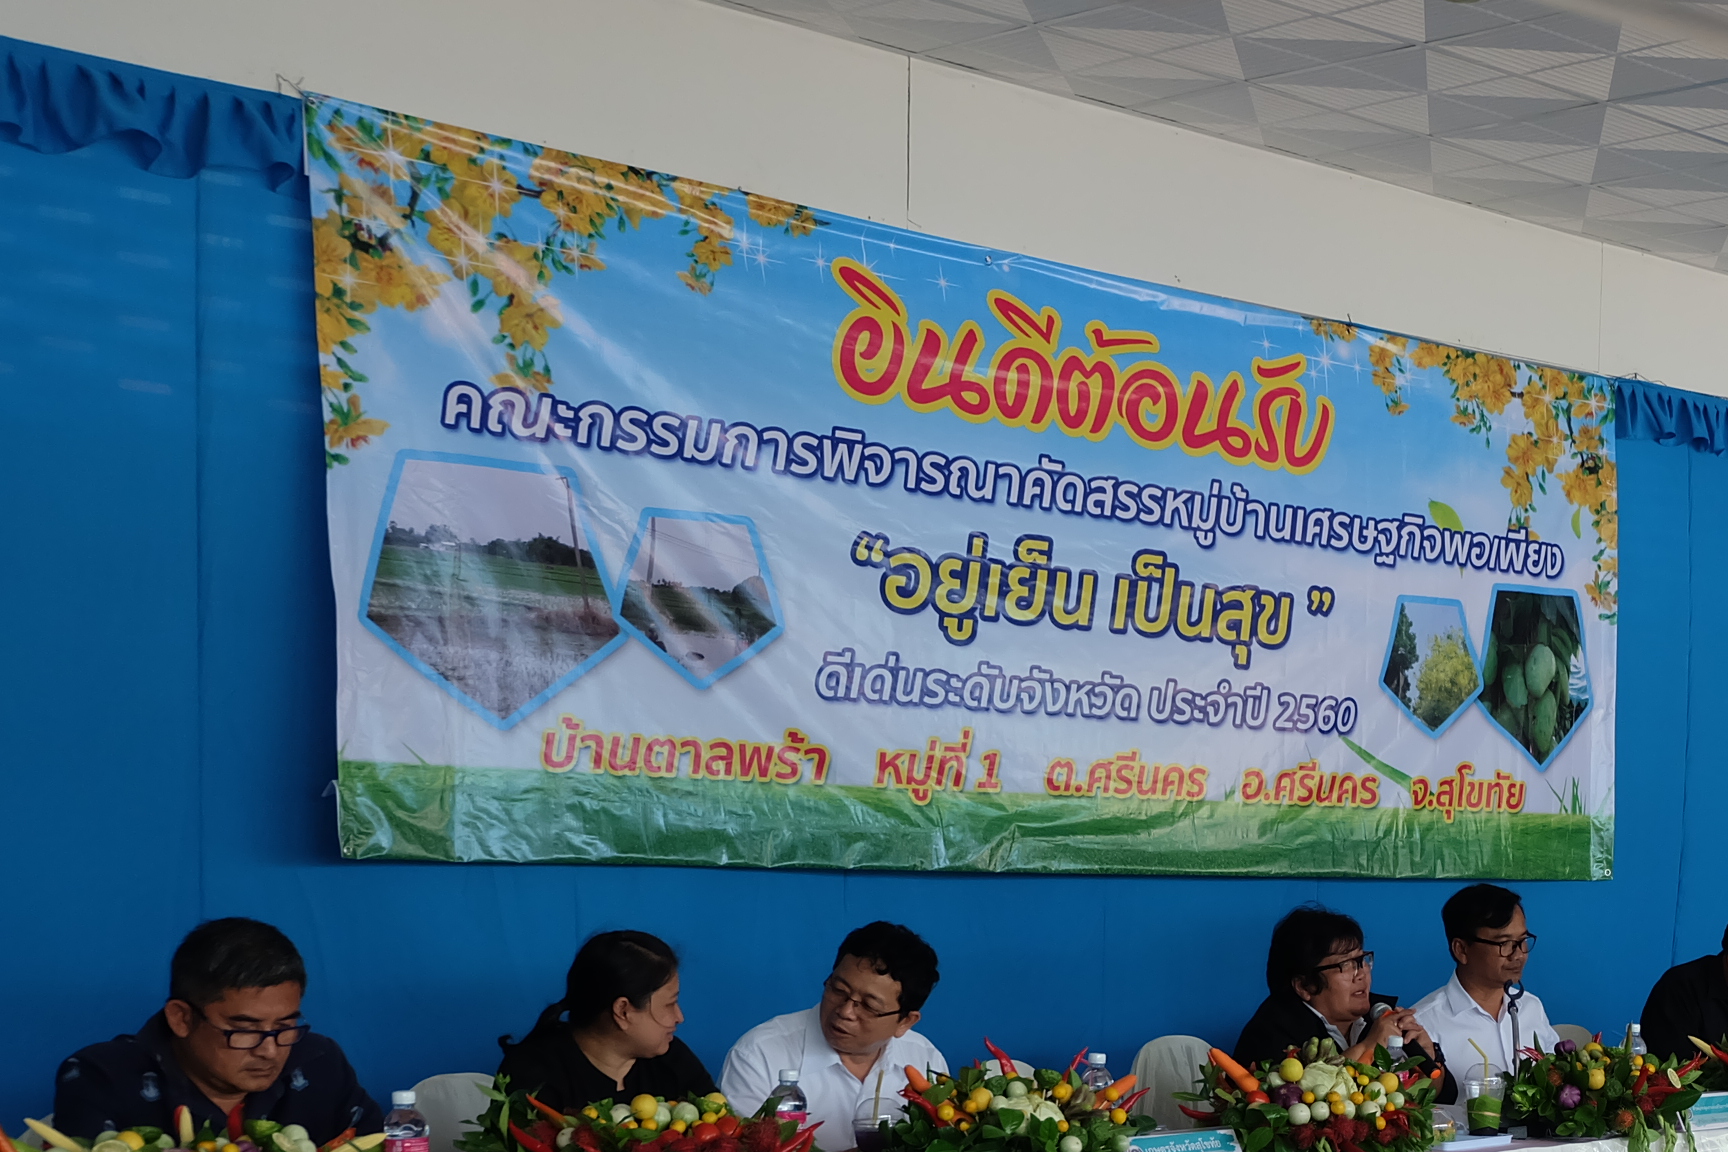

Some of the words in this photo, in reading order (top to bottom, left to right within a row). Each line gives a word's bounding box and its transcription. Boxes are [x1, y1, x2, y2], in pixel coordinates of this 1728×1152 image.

[442, 380, 1564, 579] คณะกรรมการพิจารณาคัดสรรหมู่บ้านเศรษฐกิจพอเพียง
[815, 648, 1140, 720] ดีเด่นระดับจังหวัด
[1147, 677, 1270, 729] ประจำปี
[1274, 691, 1358, 737] 2560
[542, 713, 830, 786] บ้านตาลพร้า
[875, 726, 973, 806] หมู่ที่
[975, 748, 1002, 794] 1
[1043, 748, 1208, 803] ต.ศรีนคร
[1241, 761, 1379, 809] อ.ศรีนคร
[1410, 762, 1526, 824] จ.สุโขทัย
